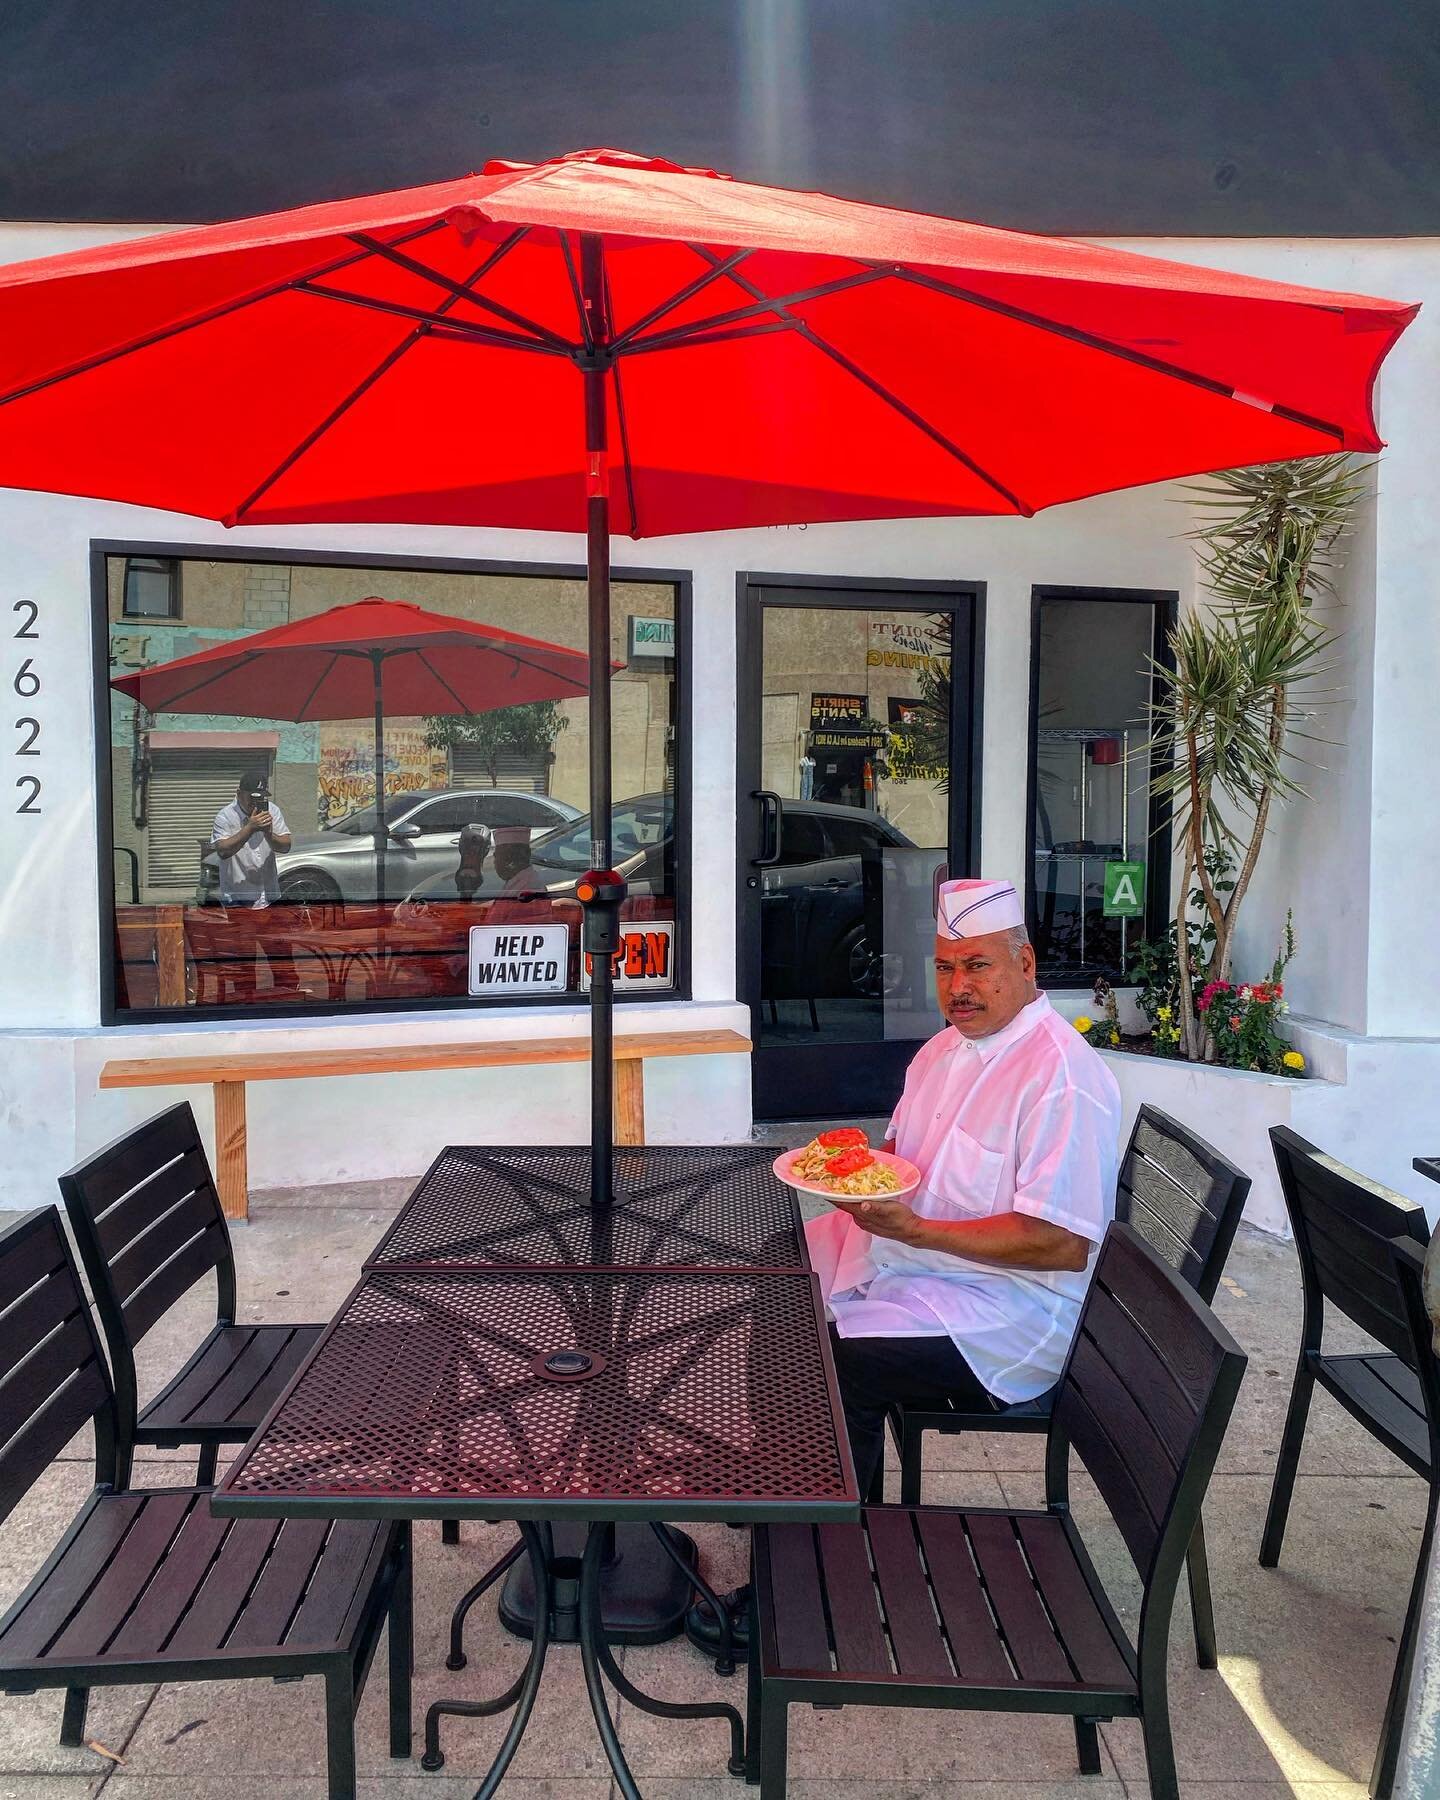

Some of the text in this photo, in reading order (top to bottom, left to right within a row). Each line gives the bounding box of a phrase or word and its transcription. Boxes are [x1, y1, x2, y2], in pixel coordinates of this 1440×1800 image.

[12, 599, 42, 814] 2622
[1111, 874, 1138, 905] A
[493, 935, 545, 957] HELP
[585, 932, 670, 980] PEN
[478, 961, 558, 984] WANTED
